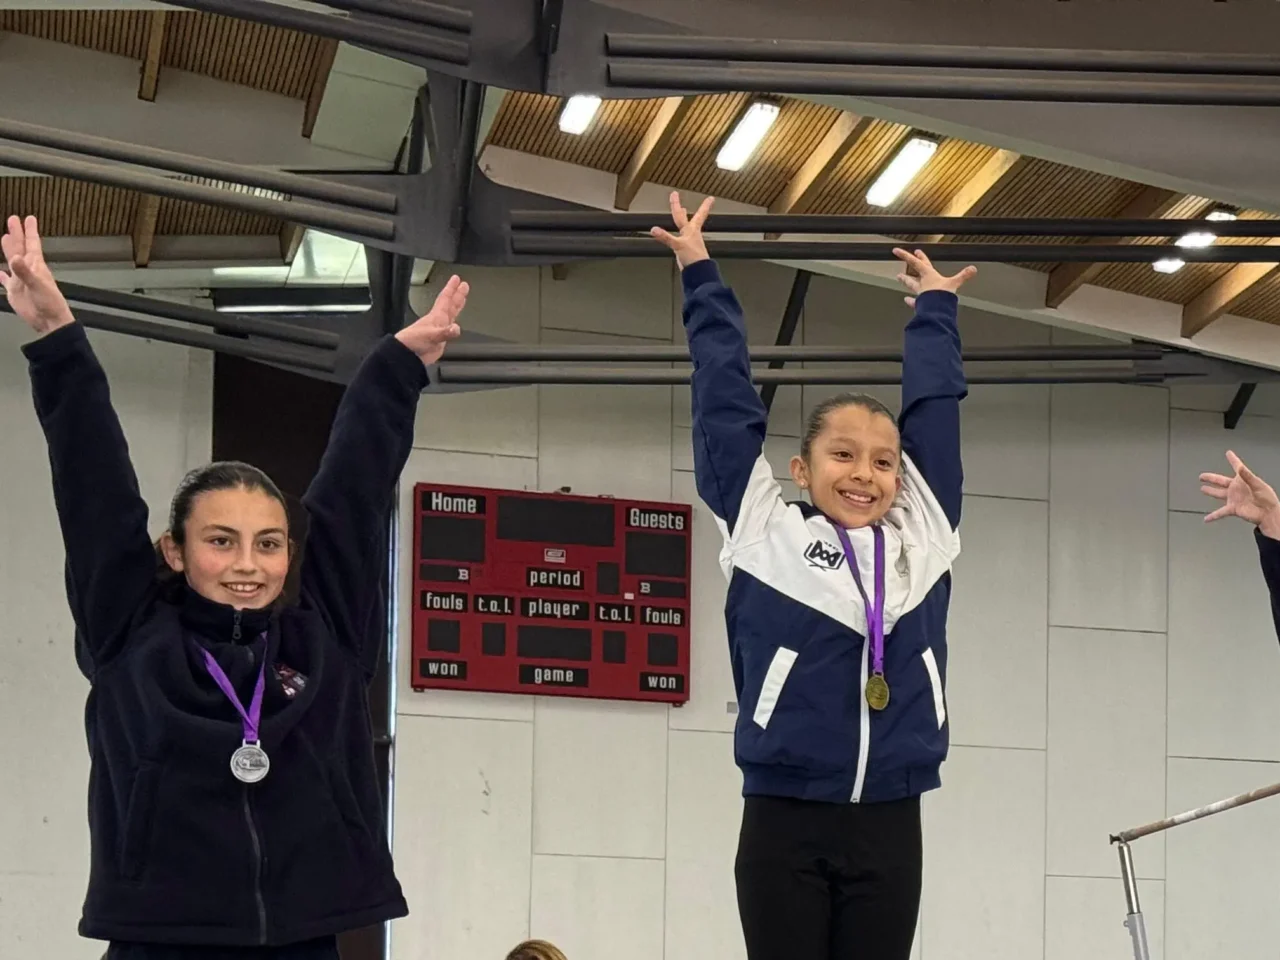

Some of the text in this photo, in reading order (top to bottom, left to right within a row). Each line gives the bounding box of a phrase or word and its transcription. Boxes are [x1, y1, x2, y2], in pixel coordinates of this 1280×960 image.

[431, 491, 477, 513] Home
[630, 508, 684, 530] Guests
[530, 570, 581, 587] period
[426, 593, 463, 610] fouls
[528, 599, 580, 618] player
[646, 608, 681, 625] fouls
[428, 662, 458, 676] won
[534, 668, 574, 684] game
[647, 676, 676, 689] won
